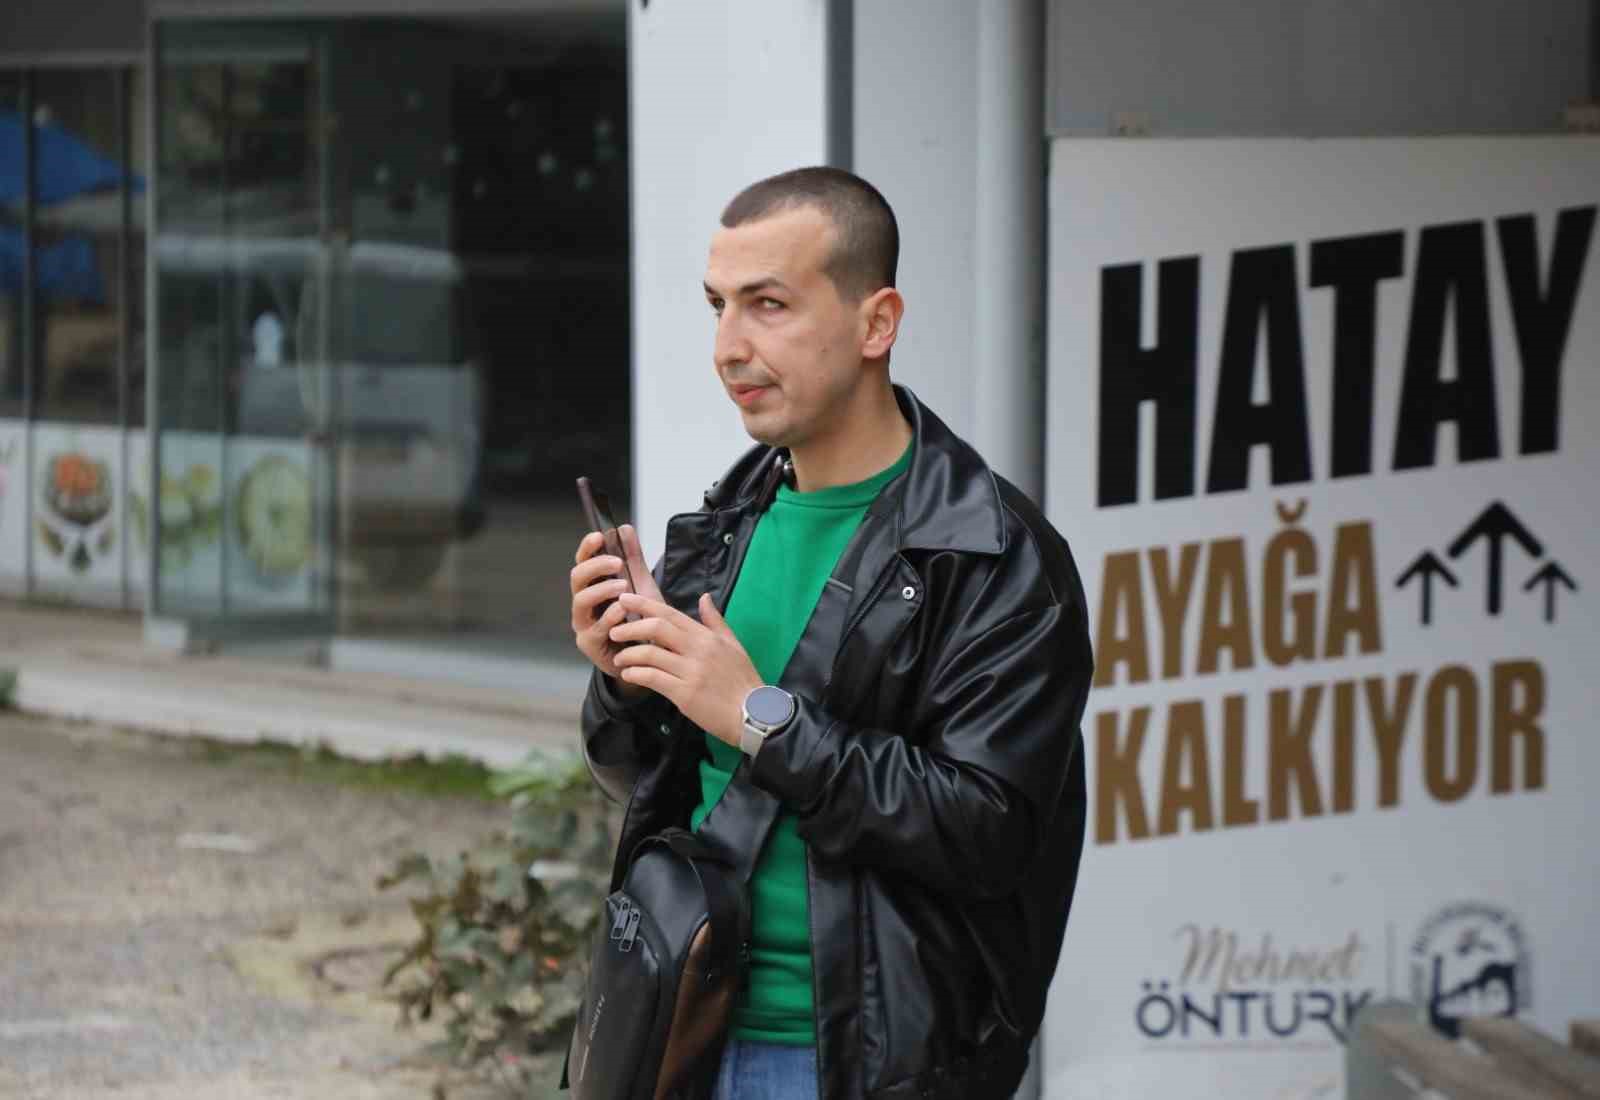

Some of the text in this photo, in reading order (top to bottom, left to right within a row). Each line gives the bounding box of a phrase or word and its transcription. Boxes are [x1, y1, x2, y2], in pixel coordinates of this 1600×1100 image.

[1097, 205, 1598, 507] HATAY
[1094, 499, 1383, 688] AYAĞA
[1094, 659, 1547, 845] KALKIYOR
[1173, 923, 1362, 991] Mehmet
